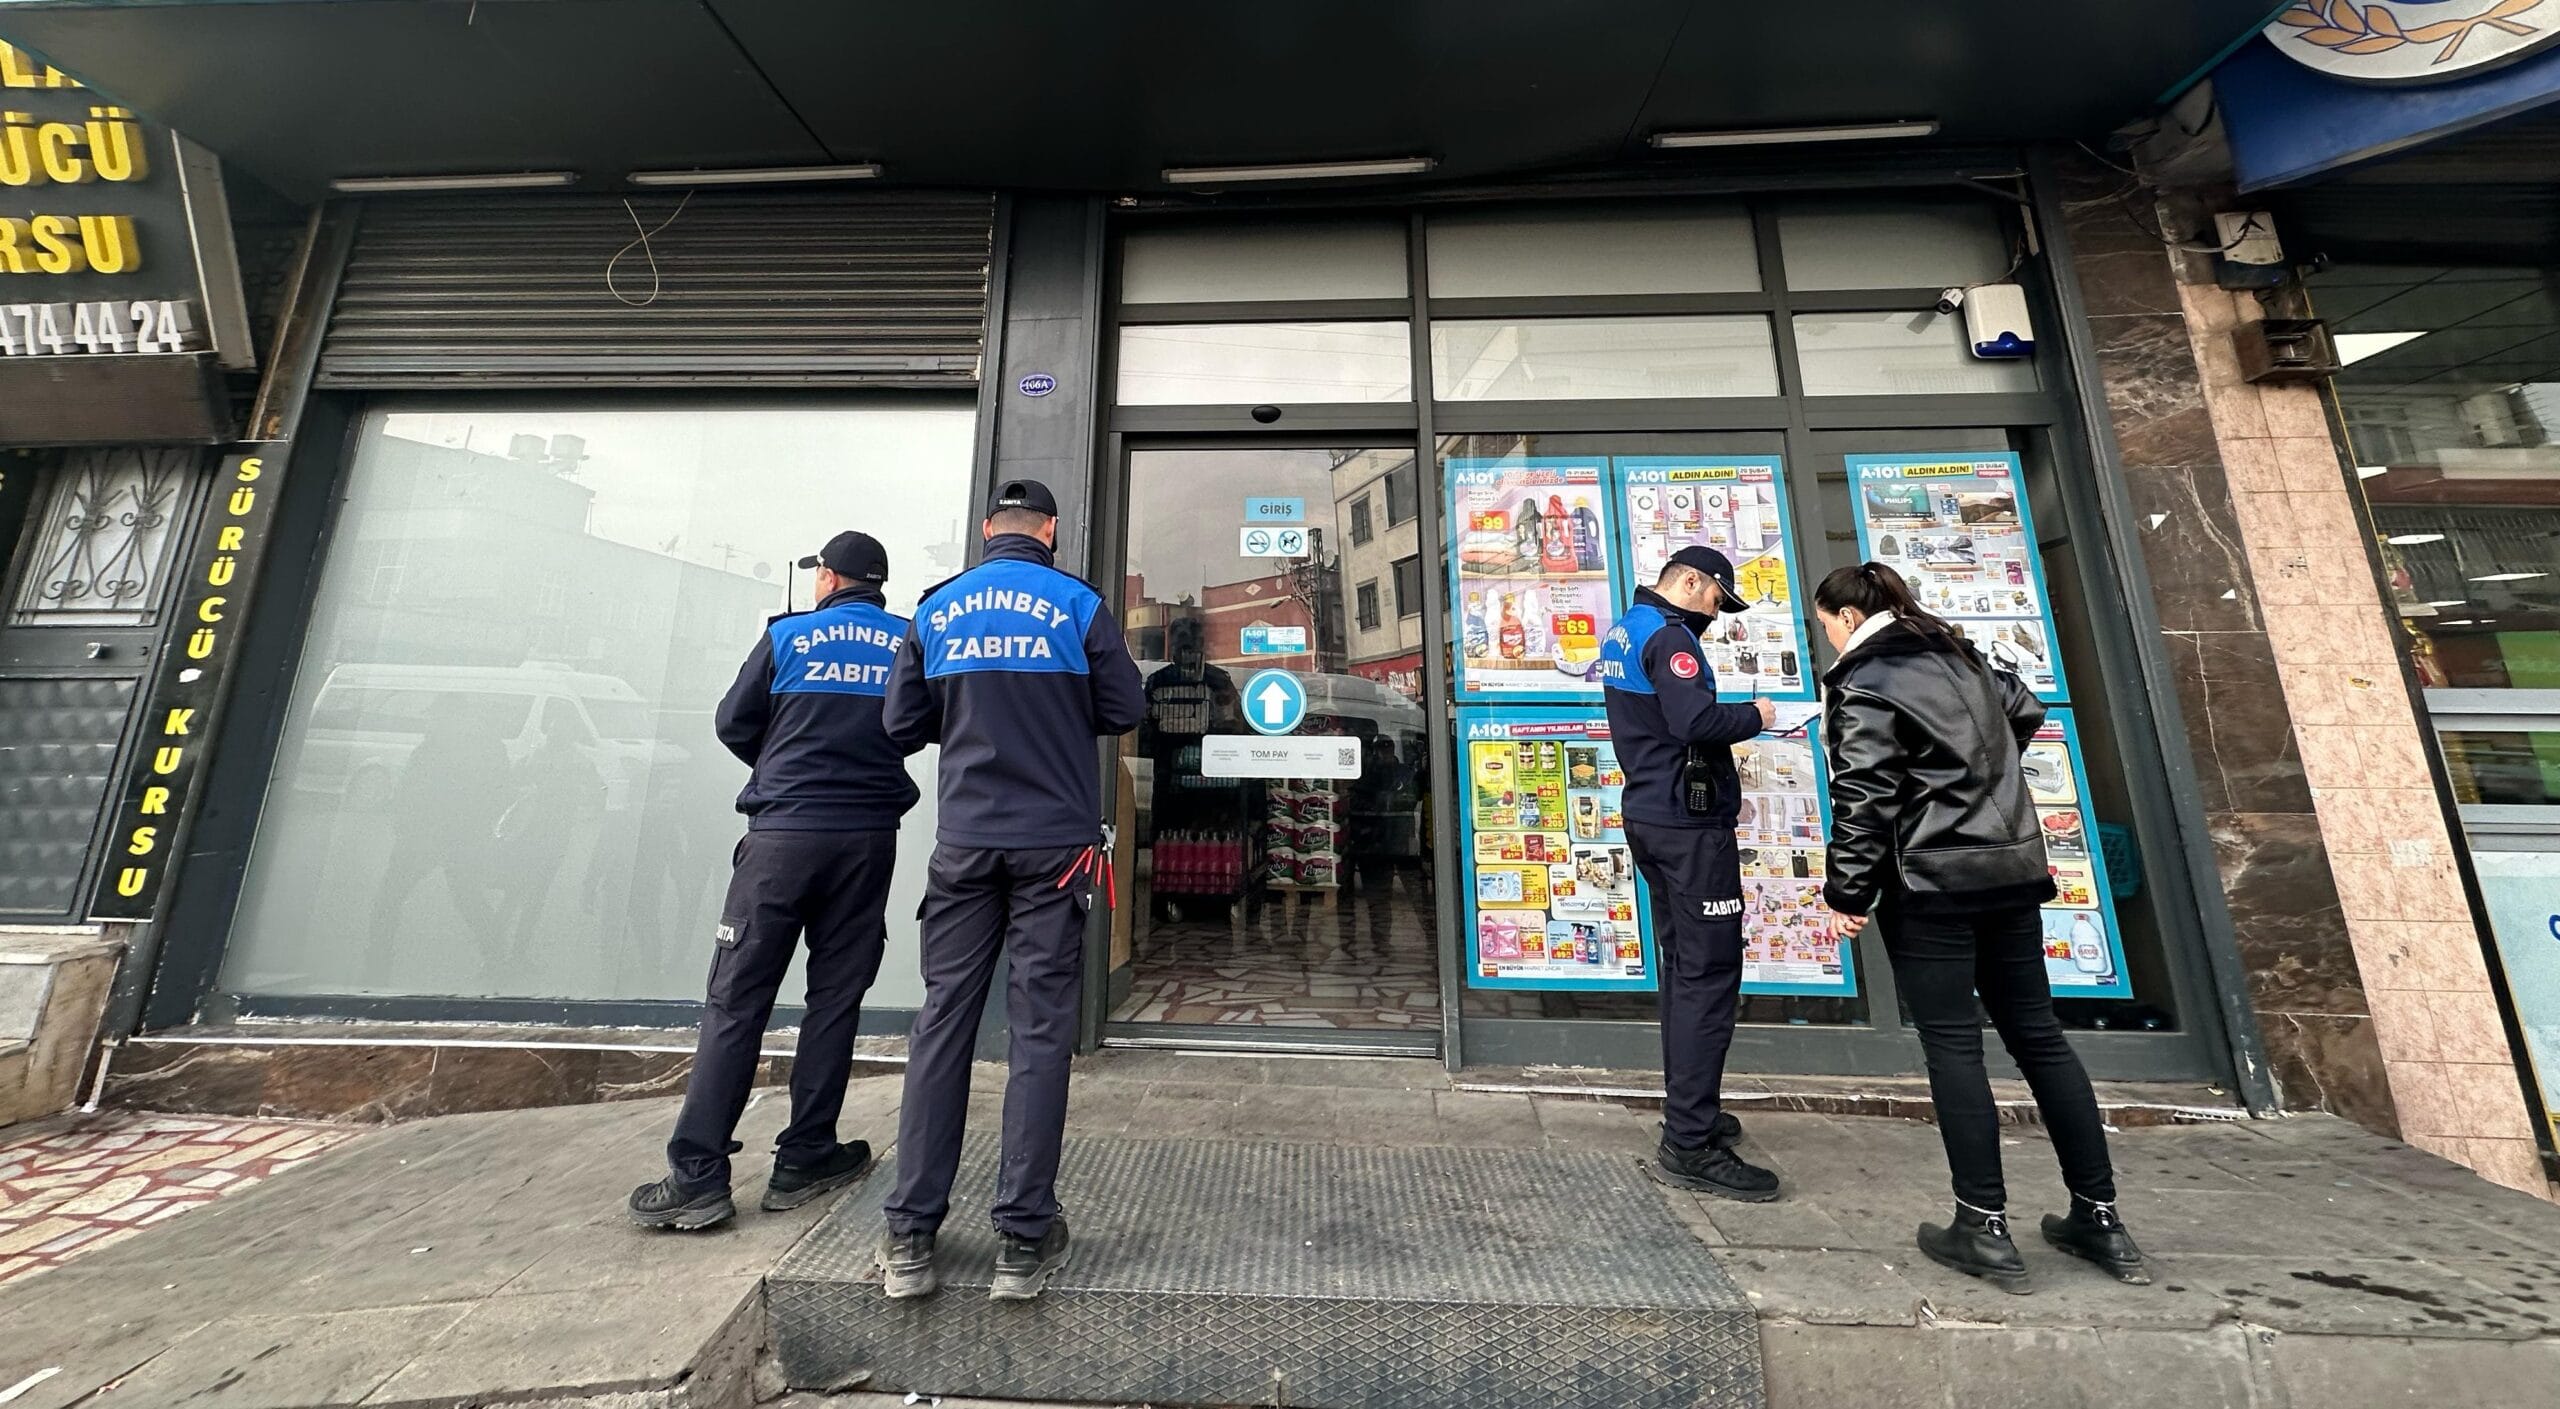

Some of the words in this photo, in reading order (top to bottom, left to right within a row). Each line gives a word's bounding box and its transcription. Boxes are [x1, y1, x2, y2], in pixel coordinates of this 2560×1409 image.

[74, 302, 124, 353] 44
[130, 301, 183, 353] 24
[1672, 472, 1701, 480] ALDIN
[1907, 467, 1936, 476] ALDIN
[1259, 503, 1293, 517] GİRİŞ
[187, 457, 262, 660] SÜRÜCÜ
[930, 586, 1070, 633] ŞAHİNBEY
[945, 635, 1053, 661] ZABITA
[804, 660, 891, 686] ZABIT
[1250, 750, 1270, 758] TOM
[1272, 750, 1288, 758] PAY
[117, 708, 195, 898] KURSU
[1702, 898, 1742, 916] ZABITA
